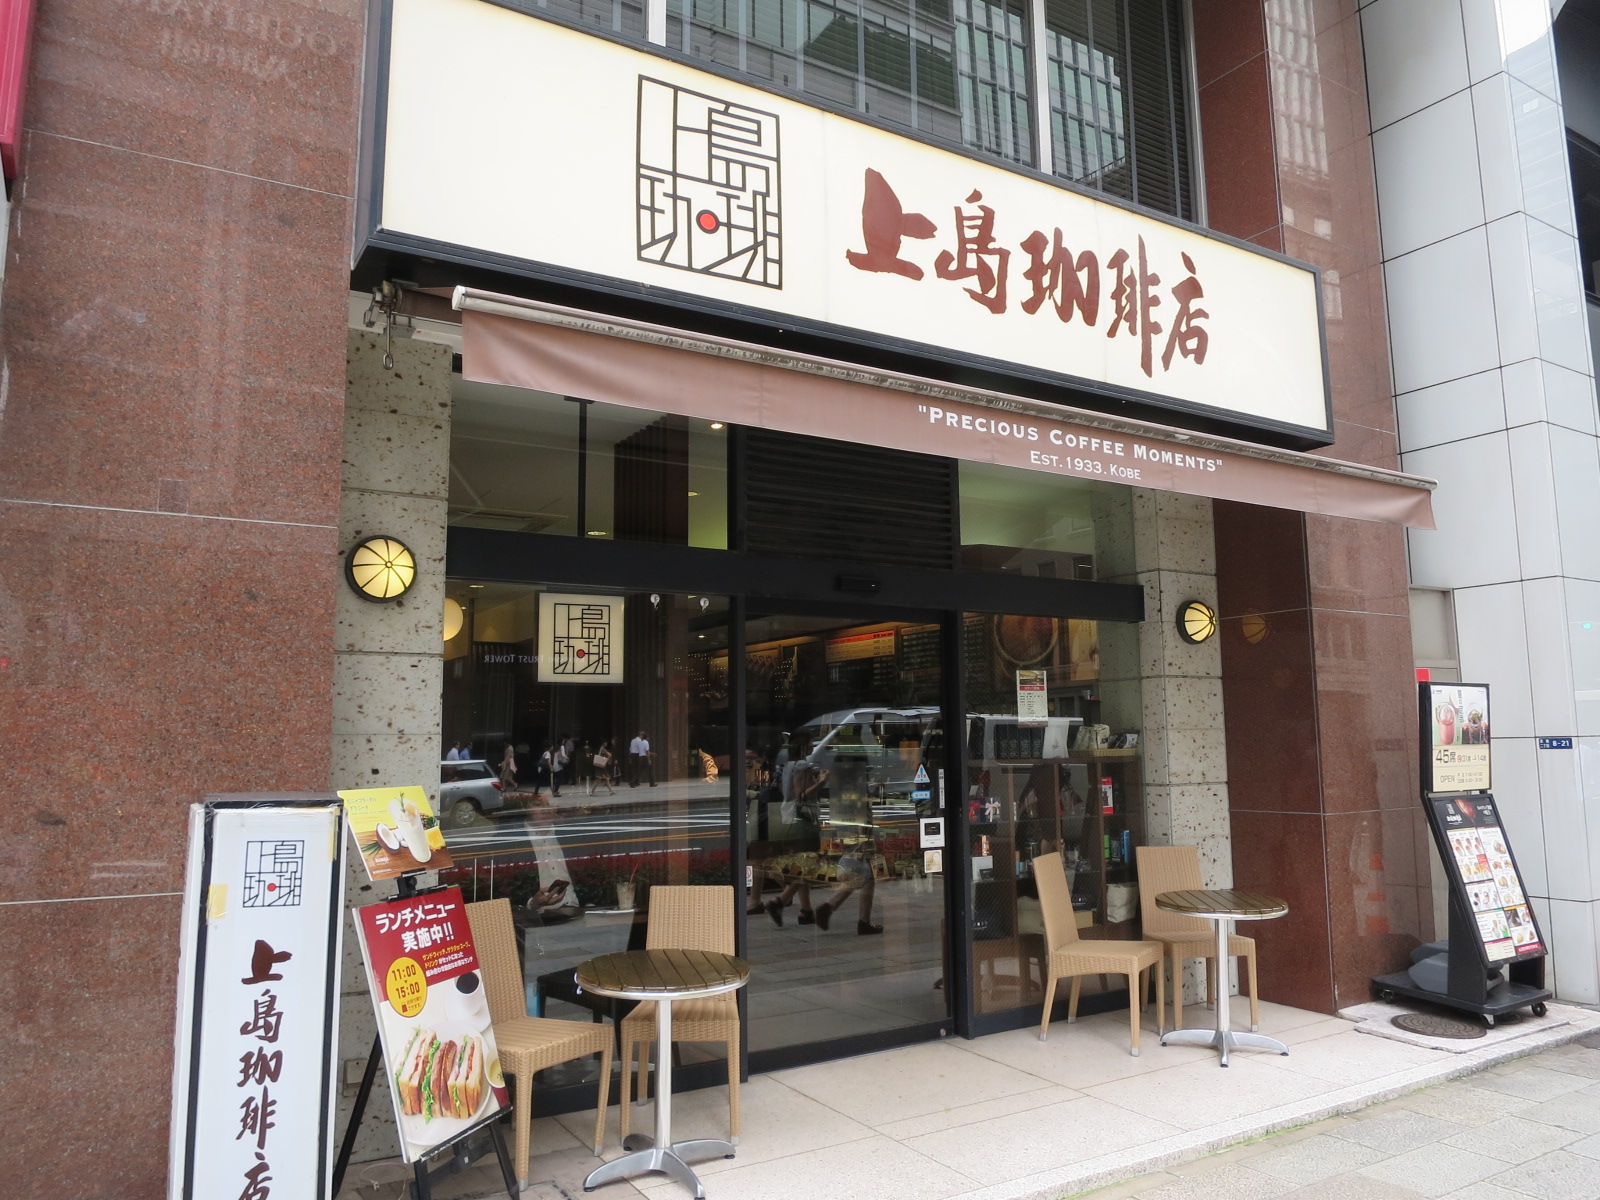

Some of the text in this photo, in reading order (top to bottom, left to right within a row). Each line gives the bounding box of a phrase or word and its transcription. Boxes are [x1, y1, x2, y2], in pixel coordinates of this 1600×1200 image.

[845, 167, 1210, 378] 上島珈琲店
[918, 404, 1223, 473] "PRECIOUS COFFEE MOMENTS"
[1440, 774, 1455, 783] OPEN
[375, 903, 456, 934] ランチメニュー
[401, 921, 455, 953] 実施中!!
[391, 964, 417, 982] 11:00
[395, 981, 421, 1000] 15:00
[236, 939, 293, 1200] 上島珈琲店
